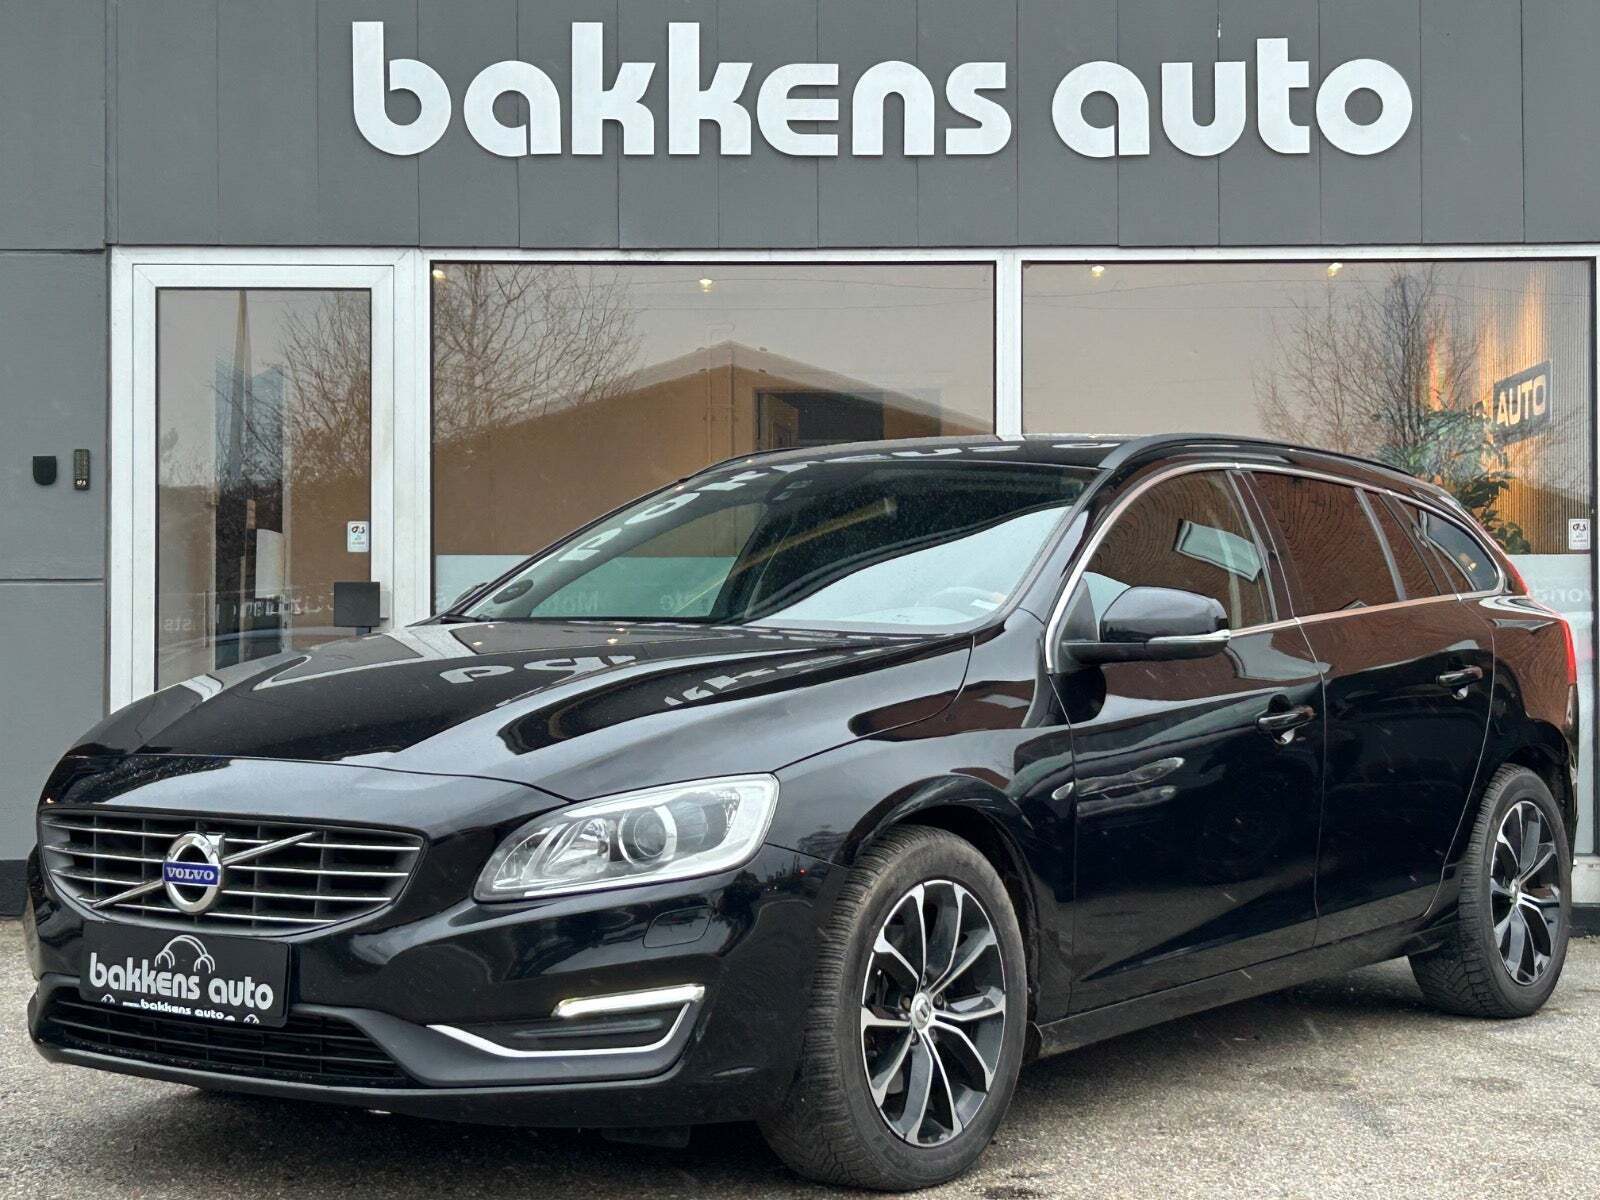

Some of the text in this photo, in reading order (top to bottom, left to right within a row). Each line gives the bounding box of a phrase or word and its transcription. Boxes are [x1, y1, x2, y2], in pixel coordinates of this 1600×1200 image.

[352, 21, 1413, 158] bakkens auto
[1496, 374, 1546, 427] AUTO
[165, 866, 215, 881] VOLVO
[89, 952, 274, 1010] bakkens auto
[140, 998, 224, 1021] bakkens auto
